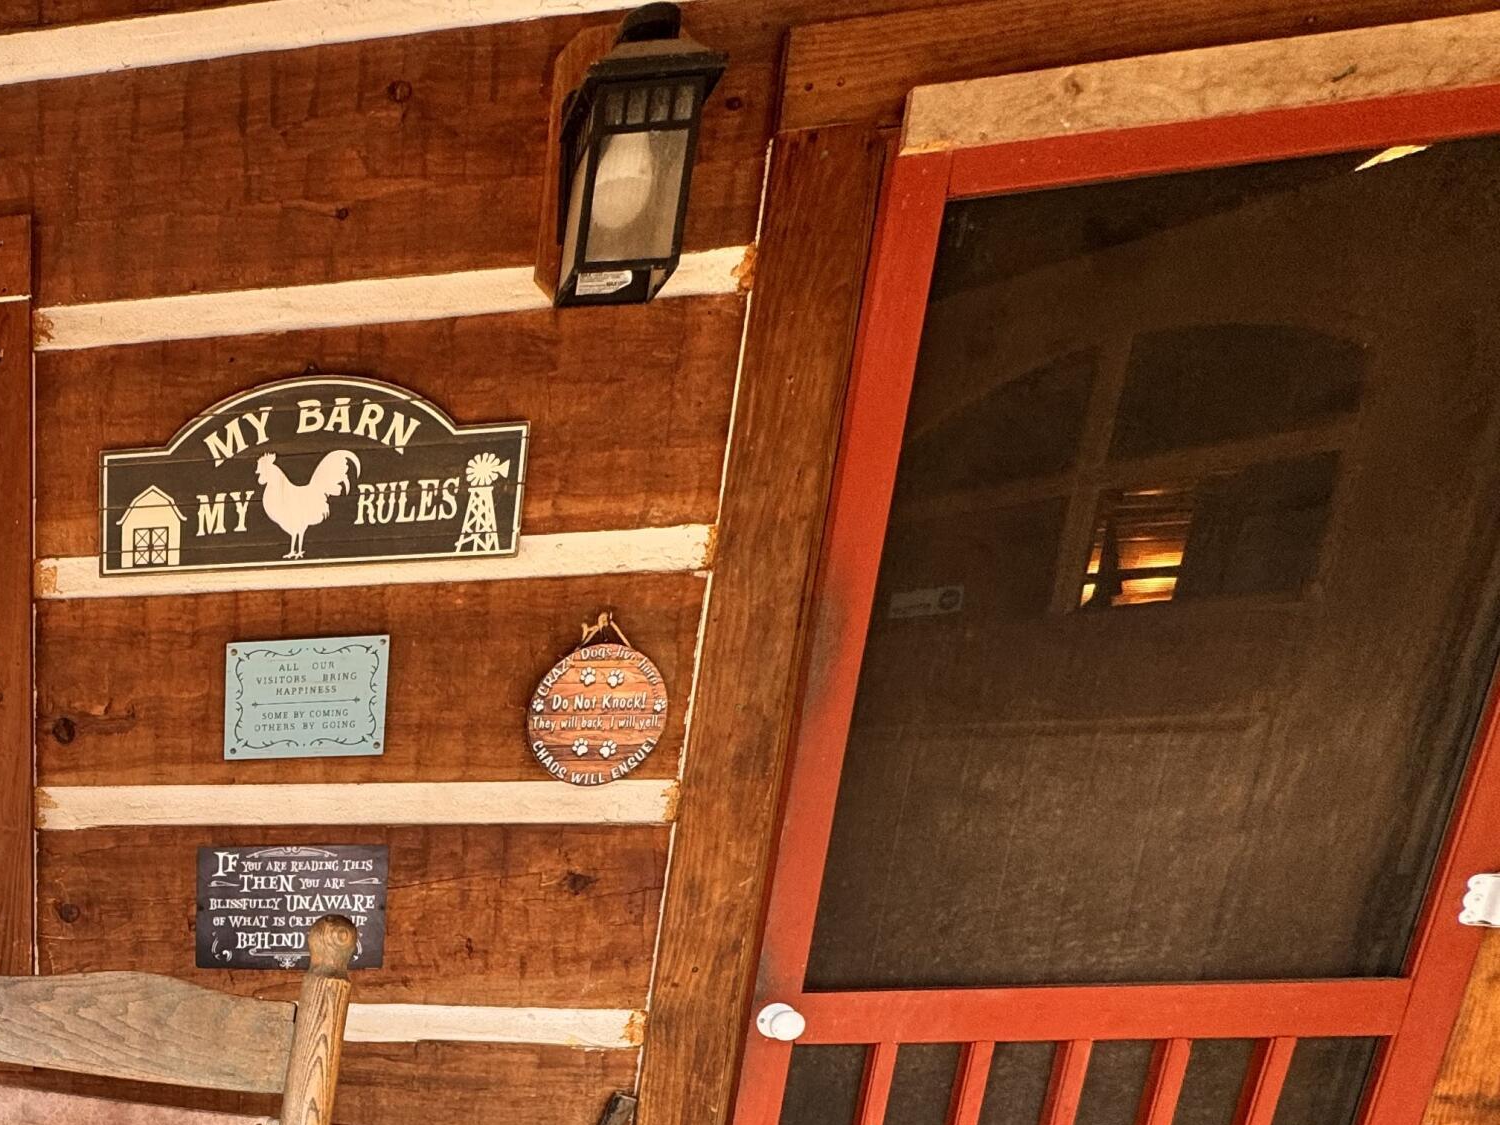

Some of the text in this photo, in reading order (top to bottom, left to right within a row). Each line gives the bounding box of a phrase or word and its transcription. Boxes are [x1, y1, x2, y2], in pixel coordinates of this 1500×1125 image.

[203, 397, 421, 467] MY BARN
[196, 476, 461, 537] MY RULES
[278, 661, 335, 672] ALL OUR
[537, 653, 575, 697] CRAZY
[581, 647, 612, 660] Dogs
[256, 672, 358, 685] VISITORS BRING
[276, 685, 337, 696] HAPPINESS
[552, 692, 647, 710] Do Not Knock!
[262, 708, 349, 720] SOME BY COMING
[254, 720, 356, 732] OTHERS BY GOING
[532, 716, 556, 733] They
[560, 716, 578, 729] will
[618, 716, 636, 728] will
[532, 740, 567, 780] CHAOS
[570, 771, 606, 785] WILL
[212, 851, 373, 877] IF YOU ARE READING THIS
[239, 874, 346, 893] THEN YOU ARE
[209, 893, 376, 912] BLISSFULLY UNAWARE
[213, 916, 227, 926] OF
[229, 916, 269, 928] WHAT
[272, 916, 286, 926] IS
[236, 931, 305, 949] BEHIND
